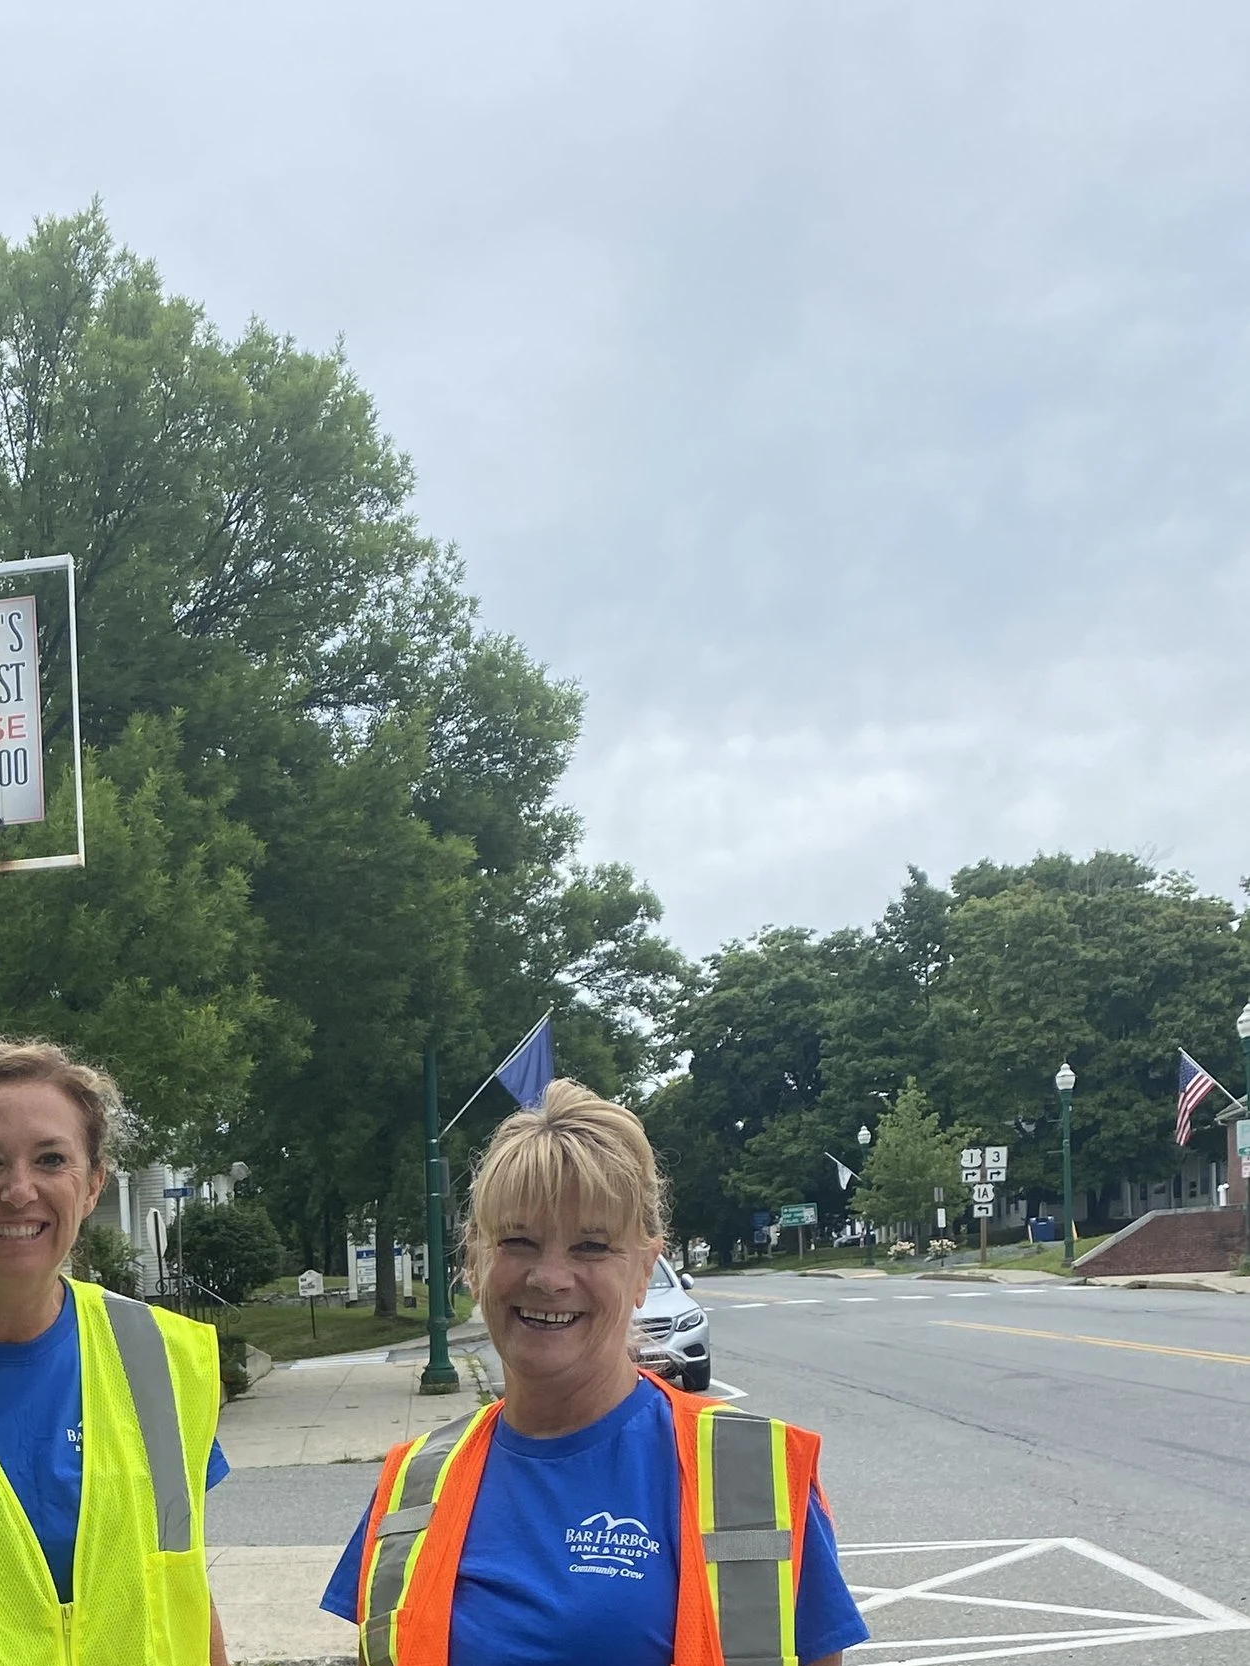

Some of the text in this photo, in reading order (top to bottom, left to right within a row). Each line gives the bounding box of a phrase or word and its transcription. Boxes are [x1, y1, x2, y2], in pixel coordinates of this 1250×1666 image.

[992, 1151, 1000, 1163] 3
[978, 1187, 989, 1199] 1A
[565, 1528, 660, 1554] BAR HARBOR
[570, 1545, 649, 1559] BANK & TRUST
[569, 1564, 645, 1580] Community Crew
